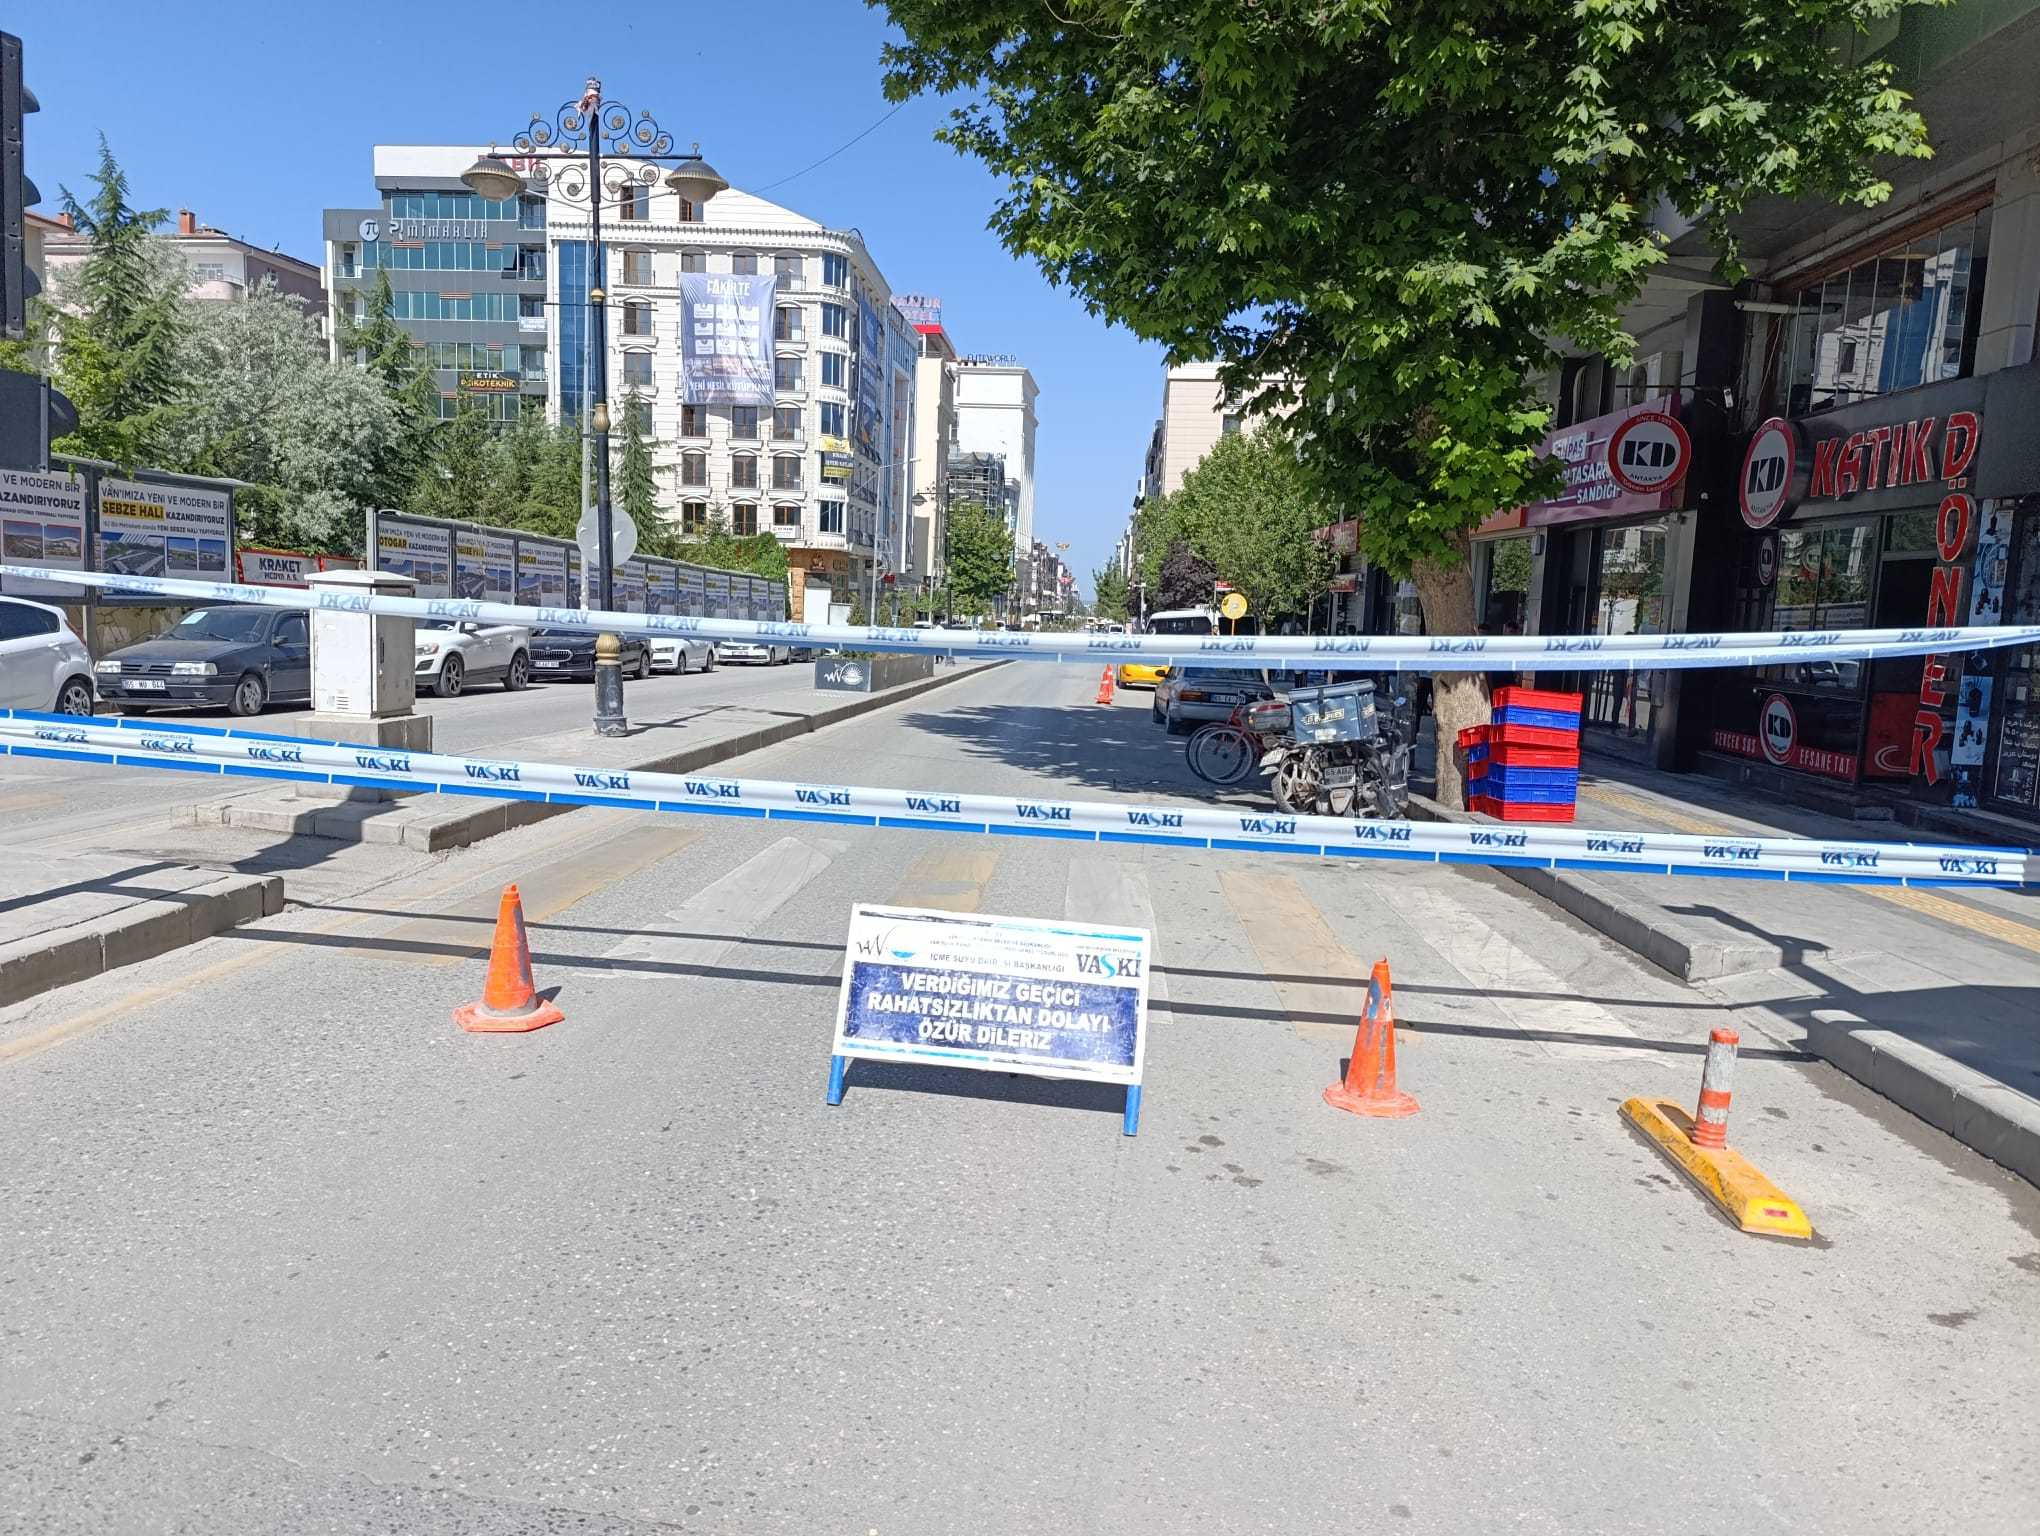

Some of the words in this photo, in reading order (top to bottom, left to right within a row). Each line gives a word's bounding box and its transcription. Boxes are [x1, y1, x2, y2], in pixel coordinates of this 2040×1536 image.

[1811, 417, 1936, 500] KATIK
[20, 476, 63, 490] MODERN
[0, 490, 81, 511] ZANDIRIYORUZ
[180, 497, 212, 508] MODERN
[102, 502, 137, 516] SEBZE
[166, 511, 225, 525] KAZANDIRIYORUZ
[378, 536, 407, 548] OTOGAR
[258, 557, 302, 573] KRAKET
[1800, 748, 1832, 770] EFSANE
[1834, 755, 1851, 775] TAT
[1015, 982, 1081, 1008] GEÇİCİ
[867, 992, 1033, 1025] RAHATSIZLIKTAN
[1035, 1010, 1111, 1033] DOLAYI
[919, 1019, 971, 1043] ÖZÜR
